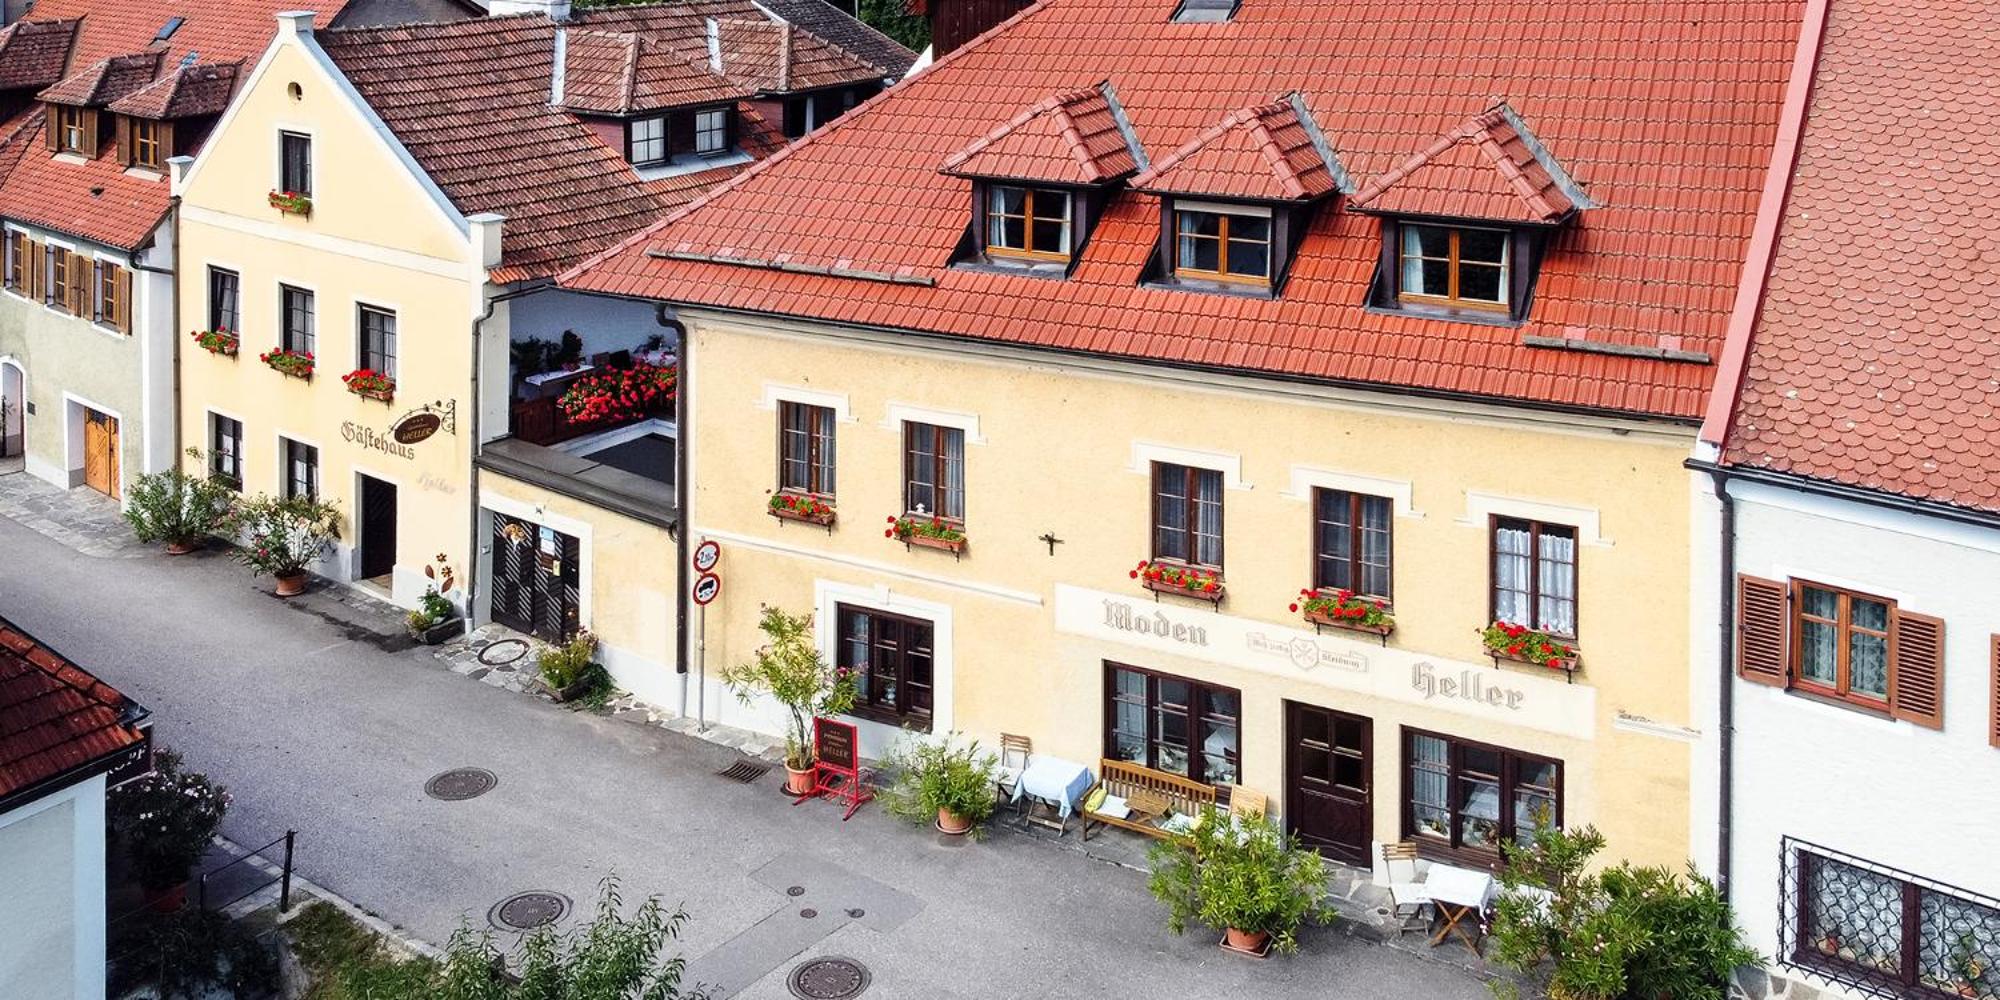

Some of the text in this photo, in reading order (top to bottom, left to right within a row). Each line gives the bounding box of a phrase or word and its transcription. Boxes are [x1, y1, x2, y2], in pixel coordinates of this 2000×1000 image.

[402, 427, 433, 440] HELLER
[1102, 598, 1209, 647] Moden
[1411, 661, 1524, 711] Heller
